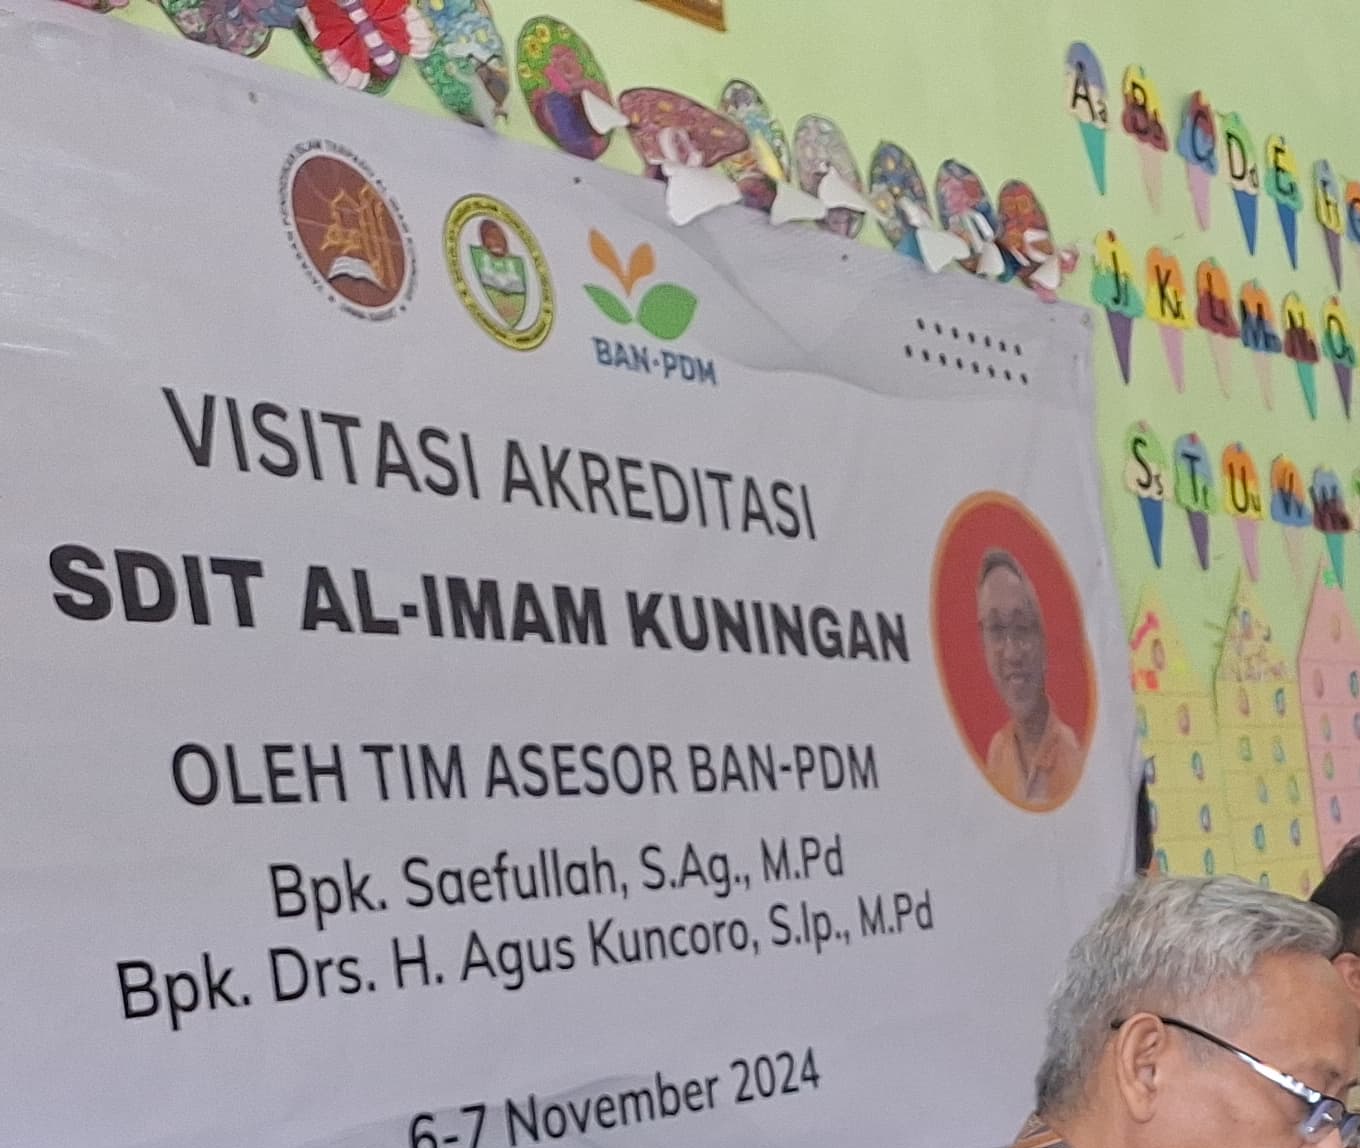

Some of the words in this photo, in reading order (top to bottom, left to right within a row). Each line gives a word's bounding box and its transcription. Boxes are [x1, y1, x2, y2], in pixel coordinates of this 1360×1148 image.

[592, 336, 717, 386] BAN-PDM
[161, 386, 480, 499] VISITASI
[503, 439, 817, 540] AKREDITASI
[48, 543, 264, 628] SDIT
[302, 564, 608, 646] AL-IMAM
[625, 590, 911, 663] KUNINGAN
[171, 742, 348, 806] OLEH
[361, 743, 468, 801] TIM
[485, 742, 678, 799] ASESOR
[688, 742, 880, 794] BAN-PDM
[268, 858, 389, 931] Bpk.
[402, 845, 629, 907] Saefullah,
[640, 842, 752, 899] S.Ag.,
[760, 833, 846, 883] M.Pd
[116, 952, 252, 1032] Bpk.
[268, 946, 377, 1002] Drs.
[391, 934, 445, 989] H.
[460, 929, 576, 992] Agus
[588, 917, 760, 967] Kuncoro,
[857, 889, 935, 937] M.Pd
[504, 1071, 720, 1148] November
[729, 1046, 822, 1105] 2024
